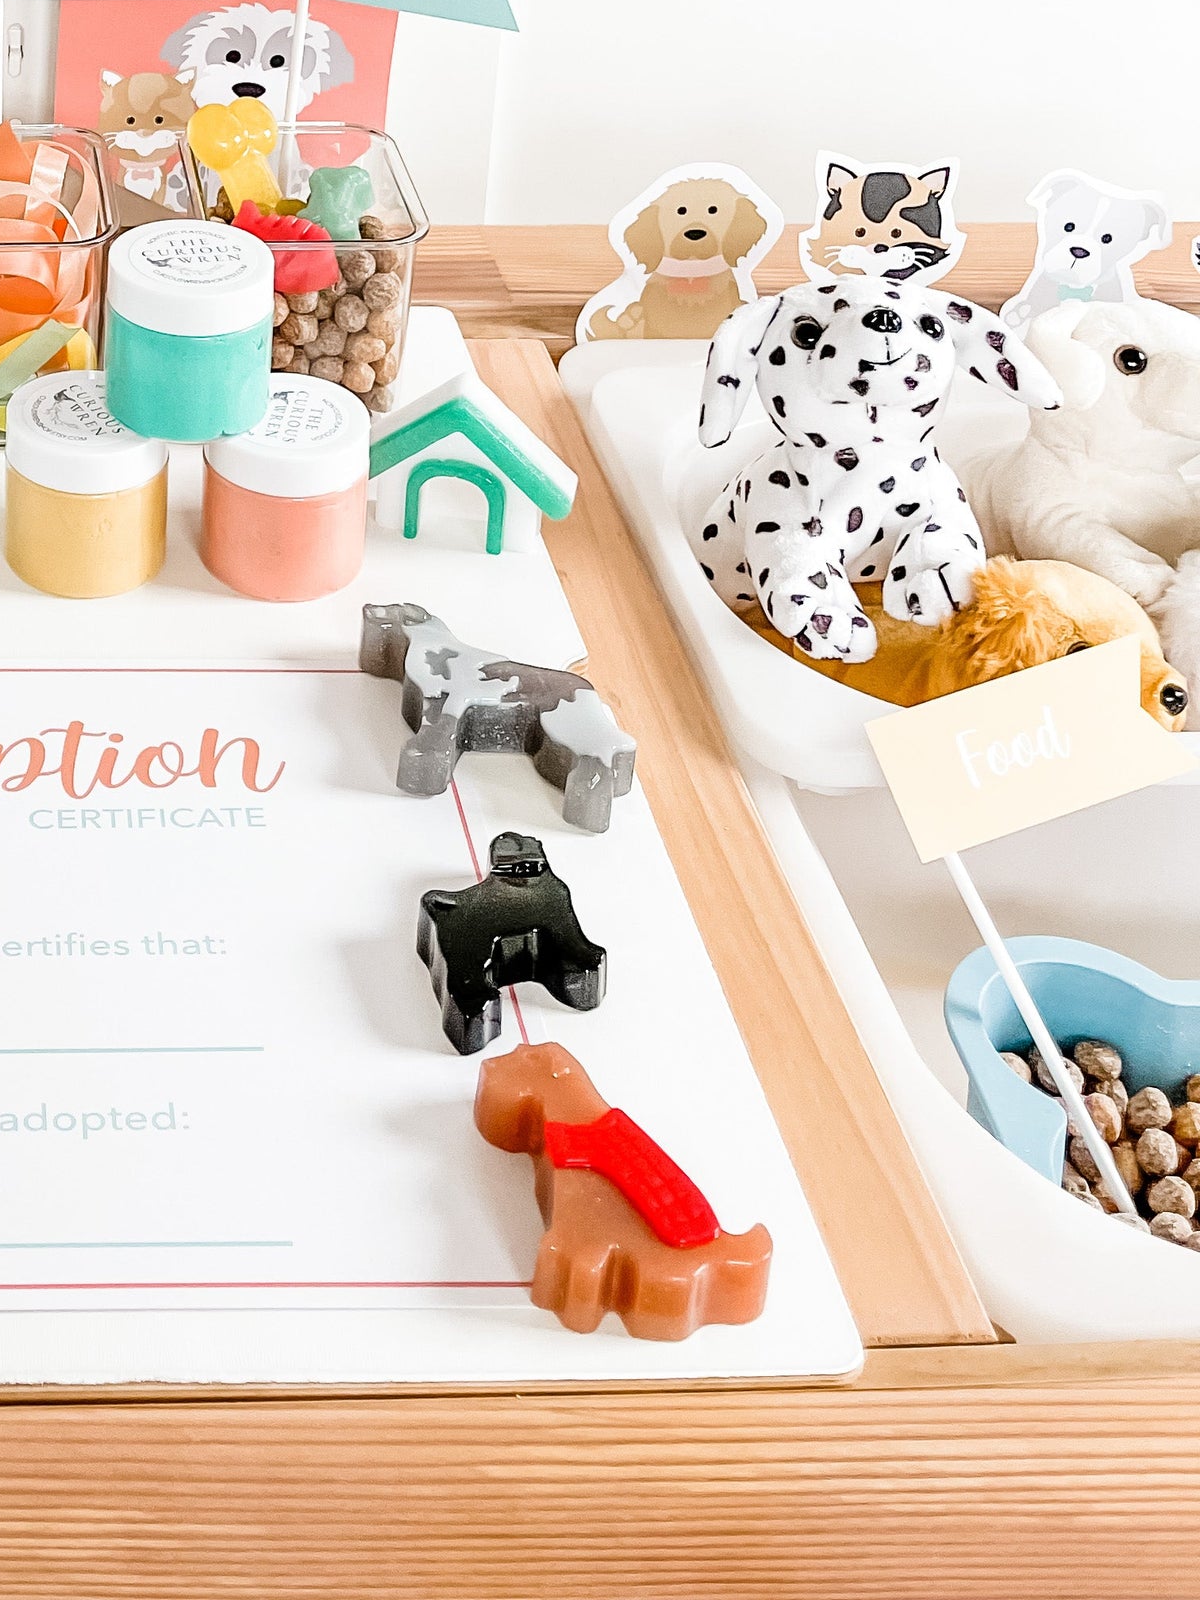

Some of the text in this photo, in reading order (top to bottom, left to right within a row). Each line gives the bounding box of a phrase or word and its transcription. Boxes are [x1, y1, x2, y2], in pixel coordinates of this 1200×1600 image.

[141, 244, 243, 258] CURIOUS
[168, 237, 210, 248] THE
[176, 253, 242, 265] WREN
[69, 384, 126, 435] CURIOUS
[70, 403, 108, 437] WREN
[282, 390, 309, 443] CURIOUS
[955, 704, 1071, 790] Food
[28, 806, 268, 830] CERTIFICATE
[140, 930, 228, 957] that:
